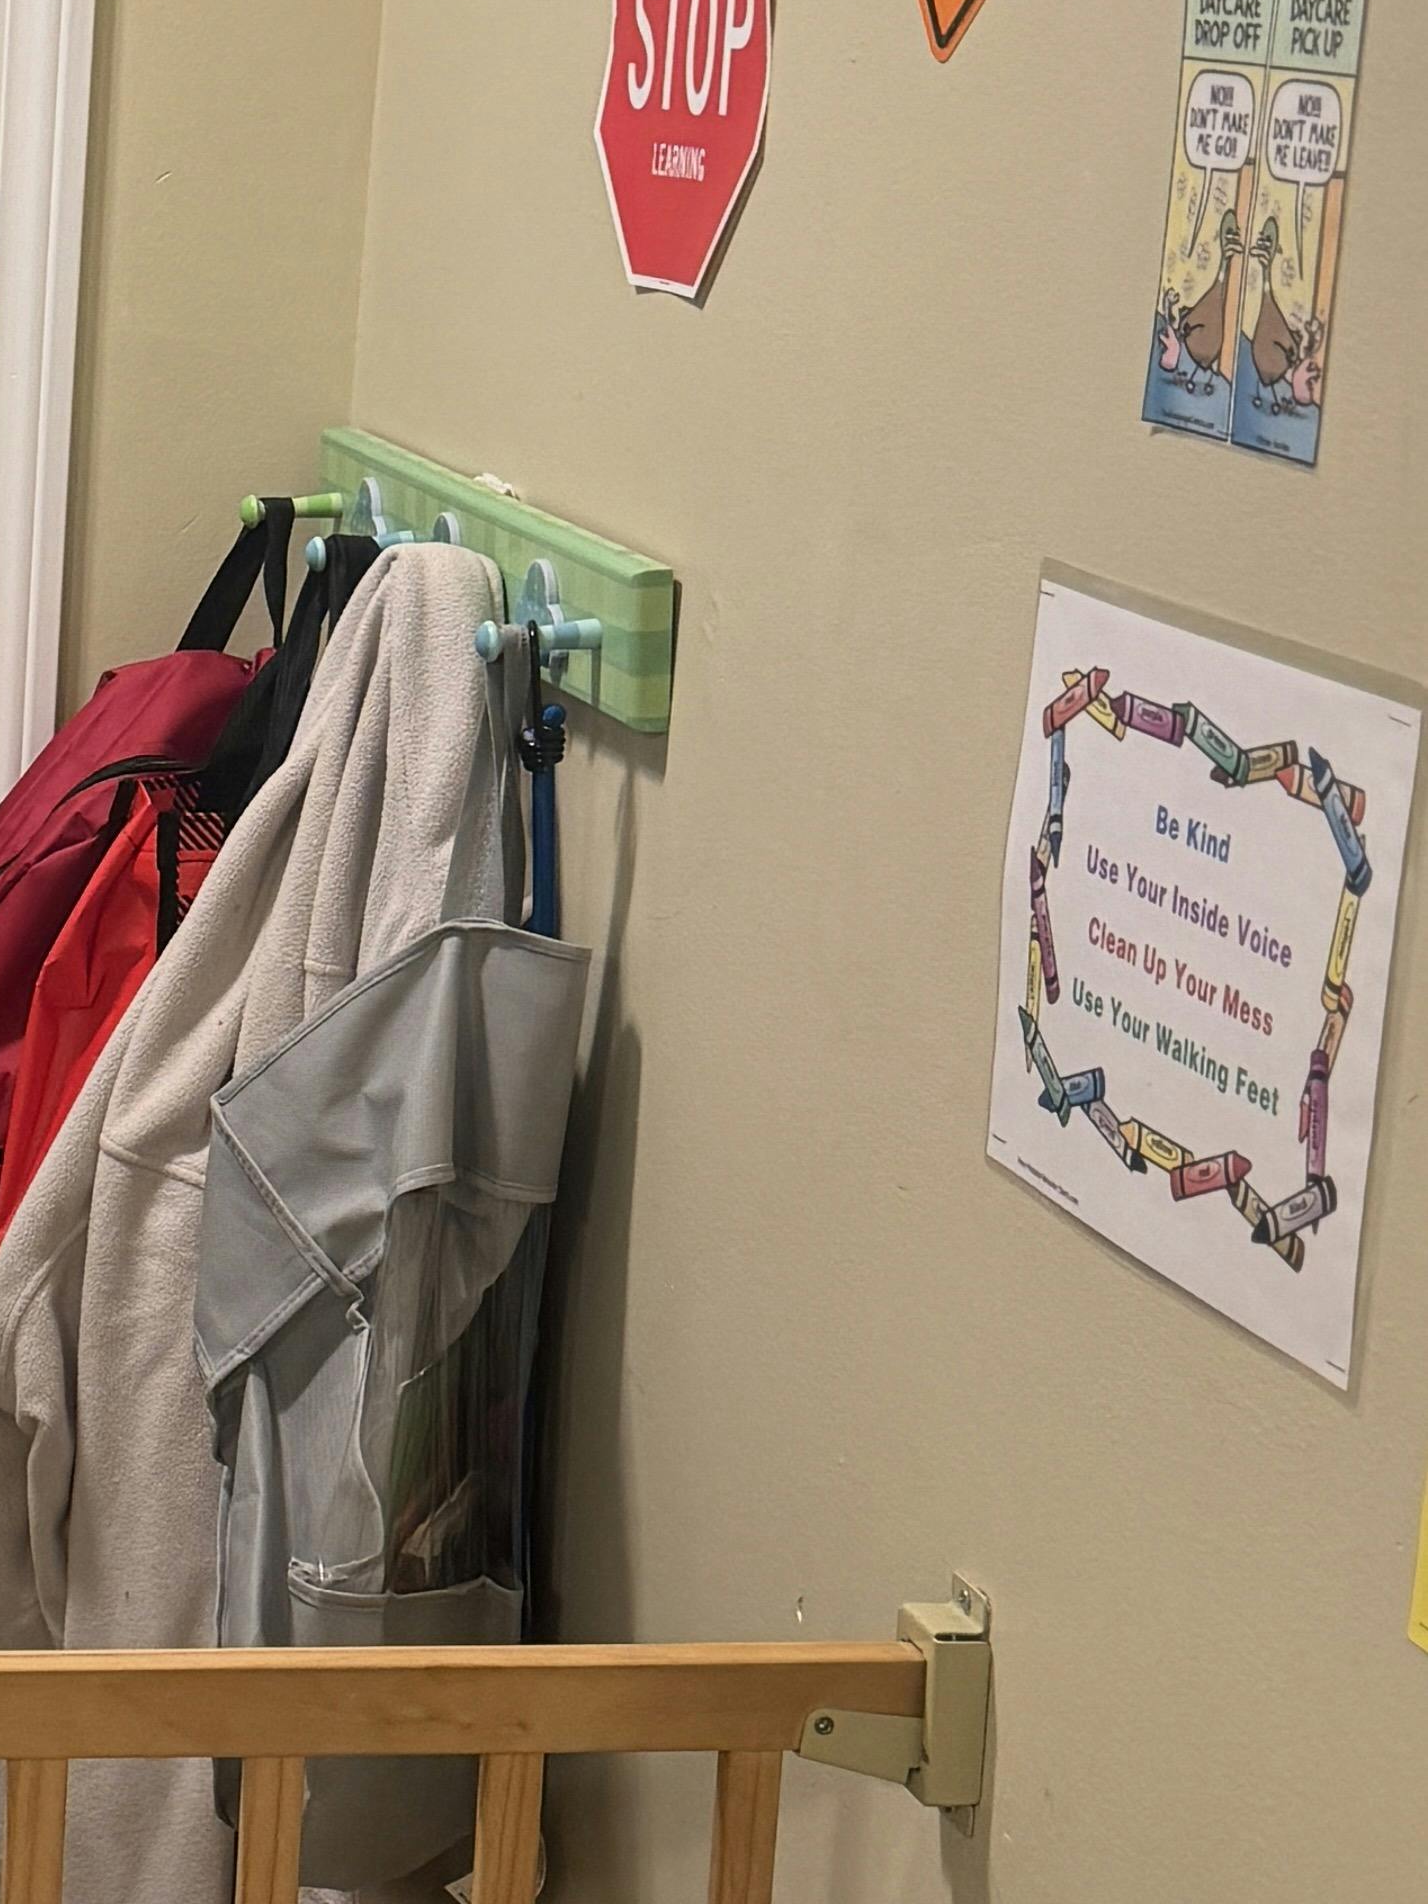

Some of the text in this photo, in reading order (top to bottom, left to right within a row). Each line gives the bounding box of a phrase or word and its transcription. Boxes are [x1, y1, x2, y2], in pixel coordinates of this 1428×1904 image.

[1194, 19, 1262, 51] DROP OFF
[1291, 27, 1343, 58] PICK UP
[1190, 107, 1249, 136] DON'T MAKE
[1273, 117, 1337, 148] DON'T MAKE
[1196, 133, 1212, 156] ME
[1274, 144, 1290, 167] ME
[651, 143, 705, 182] LEARNING
[1155, 804, 1231, 864] Be Kind
[1086, 844, 1119, 885] Use
[1126, 862, 1167, 908] Your
[1171, 884, 1229, 940] Inside
[1238, 914, 1292, 969] Voice
[1088, 916, 1274, 1037] Clean Up Your Mess
[1072, 977, 1280, 1116] Use Your Walking Feet
